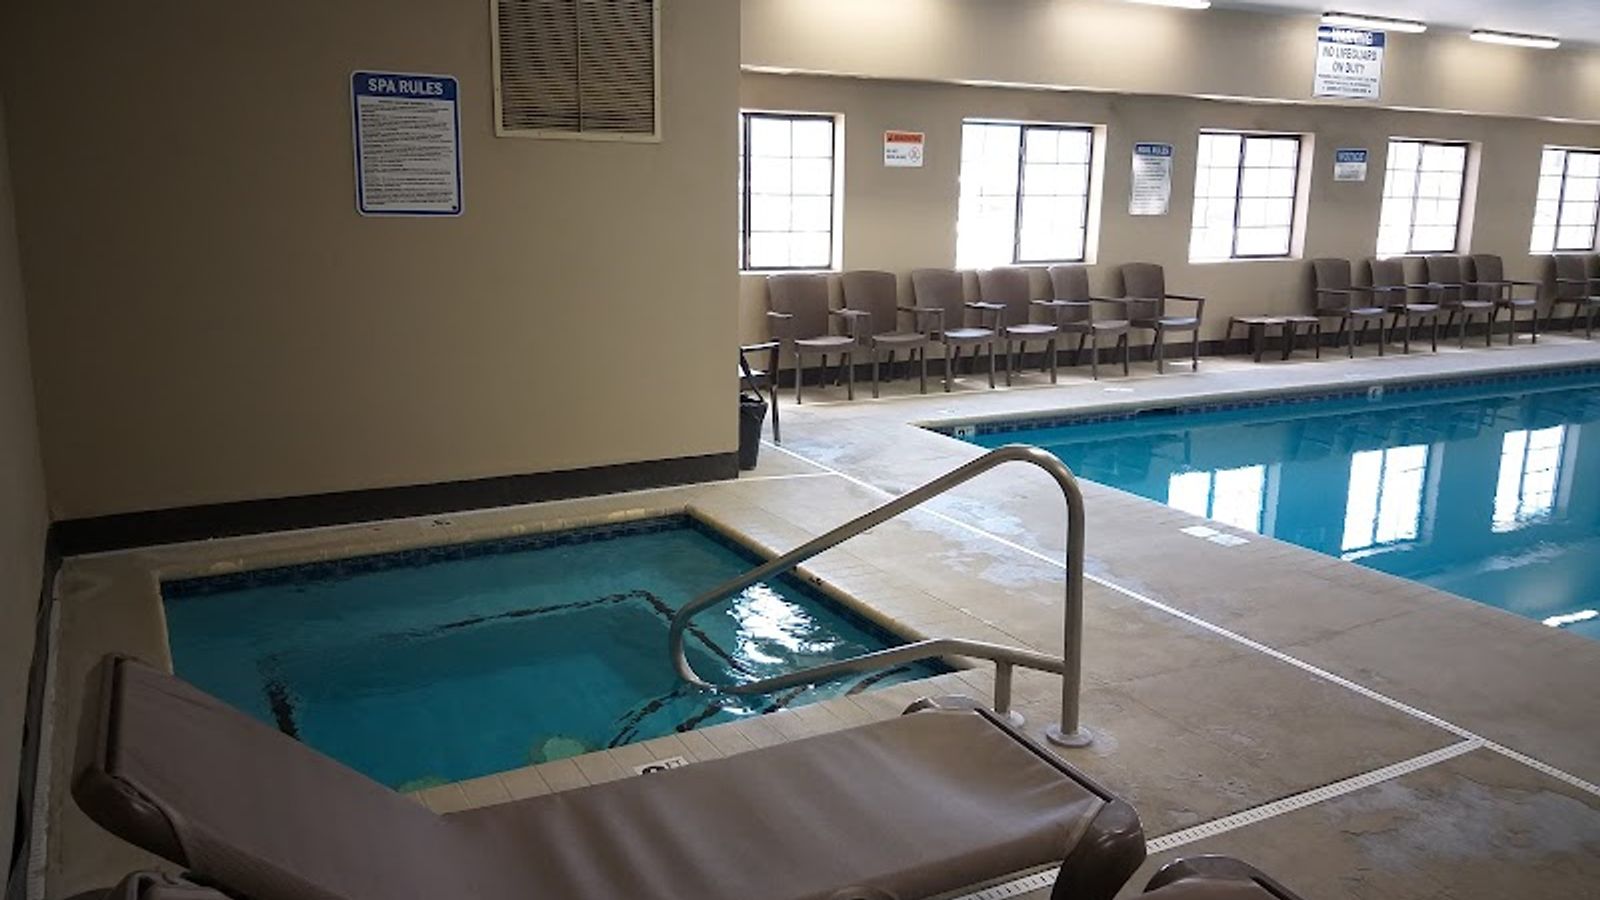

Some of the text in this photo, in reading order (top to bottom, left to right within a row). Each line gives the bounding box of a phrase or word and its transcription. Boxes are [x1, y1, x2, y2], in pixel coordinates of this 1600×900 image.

[1322, 46, 1335, 57] NO
[368, 78, 444, 95] SPA RULES
